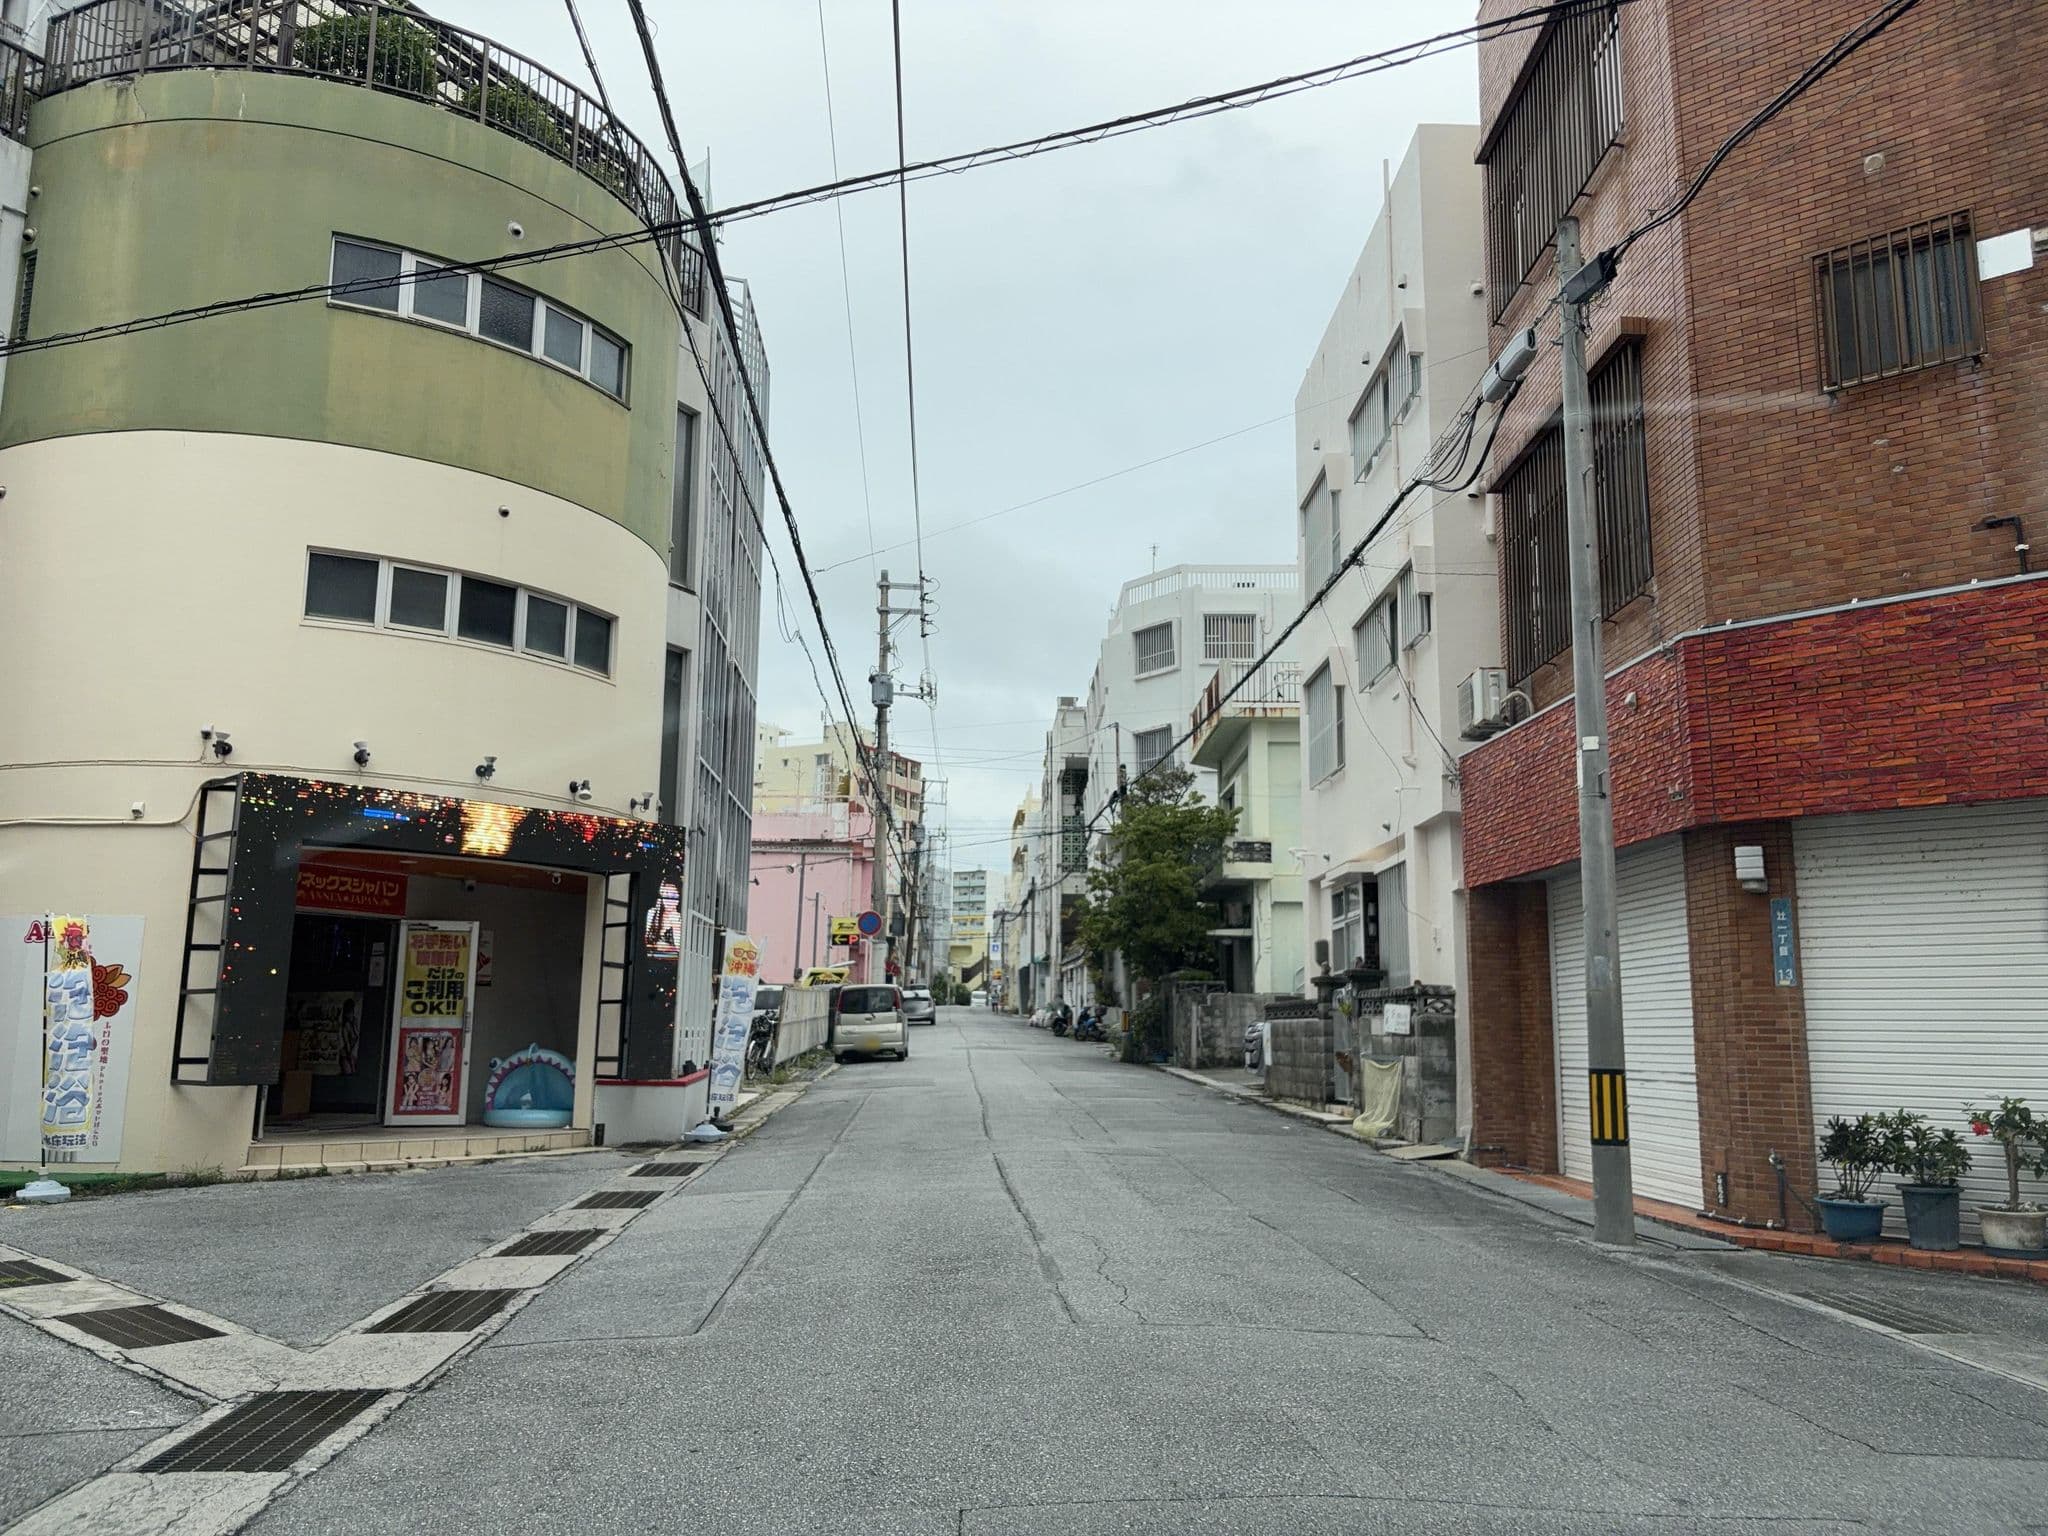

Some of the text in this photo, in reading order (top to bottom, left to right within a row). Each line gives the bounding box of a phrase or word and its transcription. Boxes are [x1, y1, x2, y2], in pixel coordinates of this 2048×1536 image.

[849, 935, 859, 945] P
[1778, 969, 1793, 980] 13
[411, 1001, 457, 1015] OK!!
